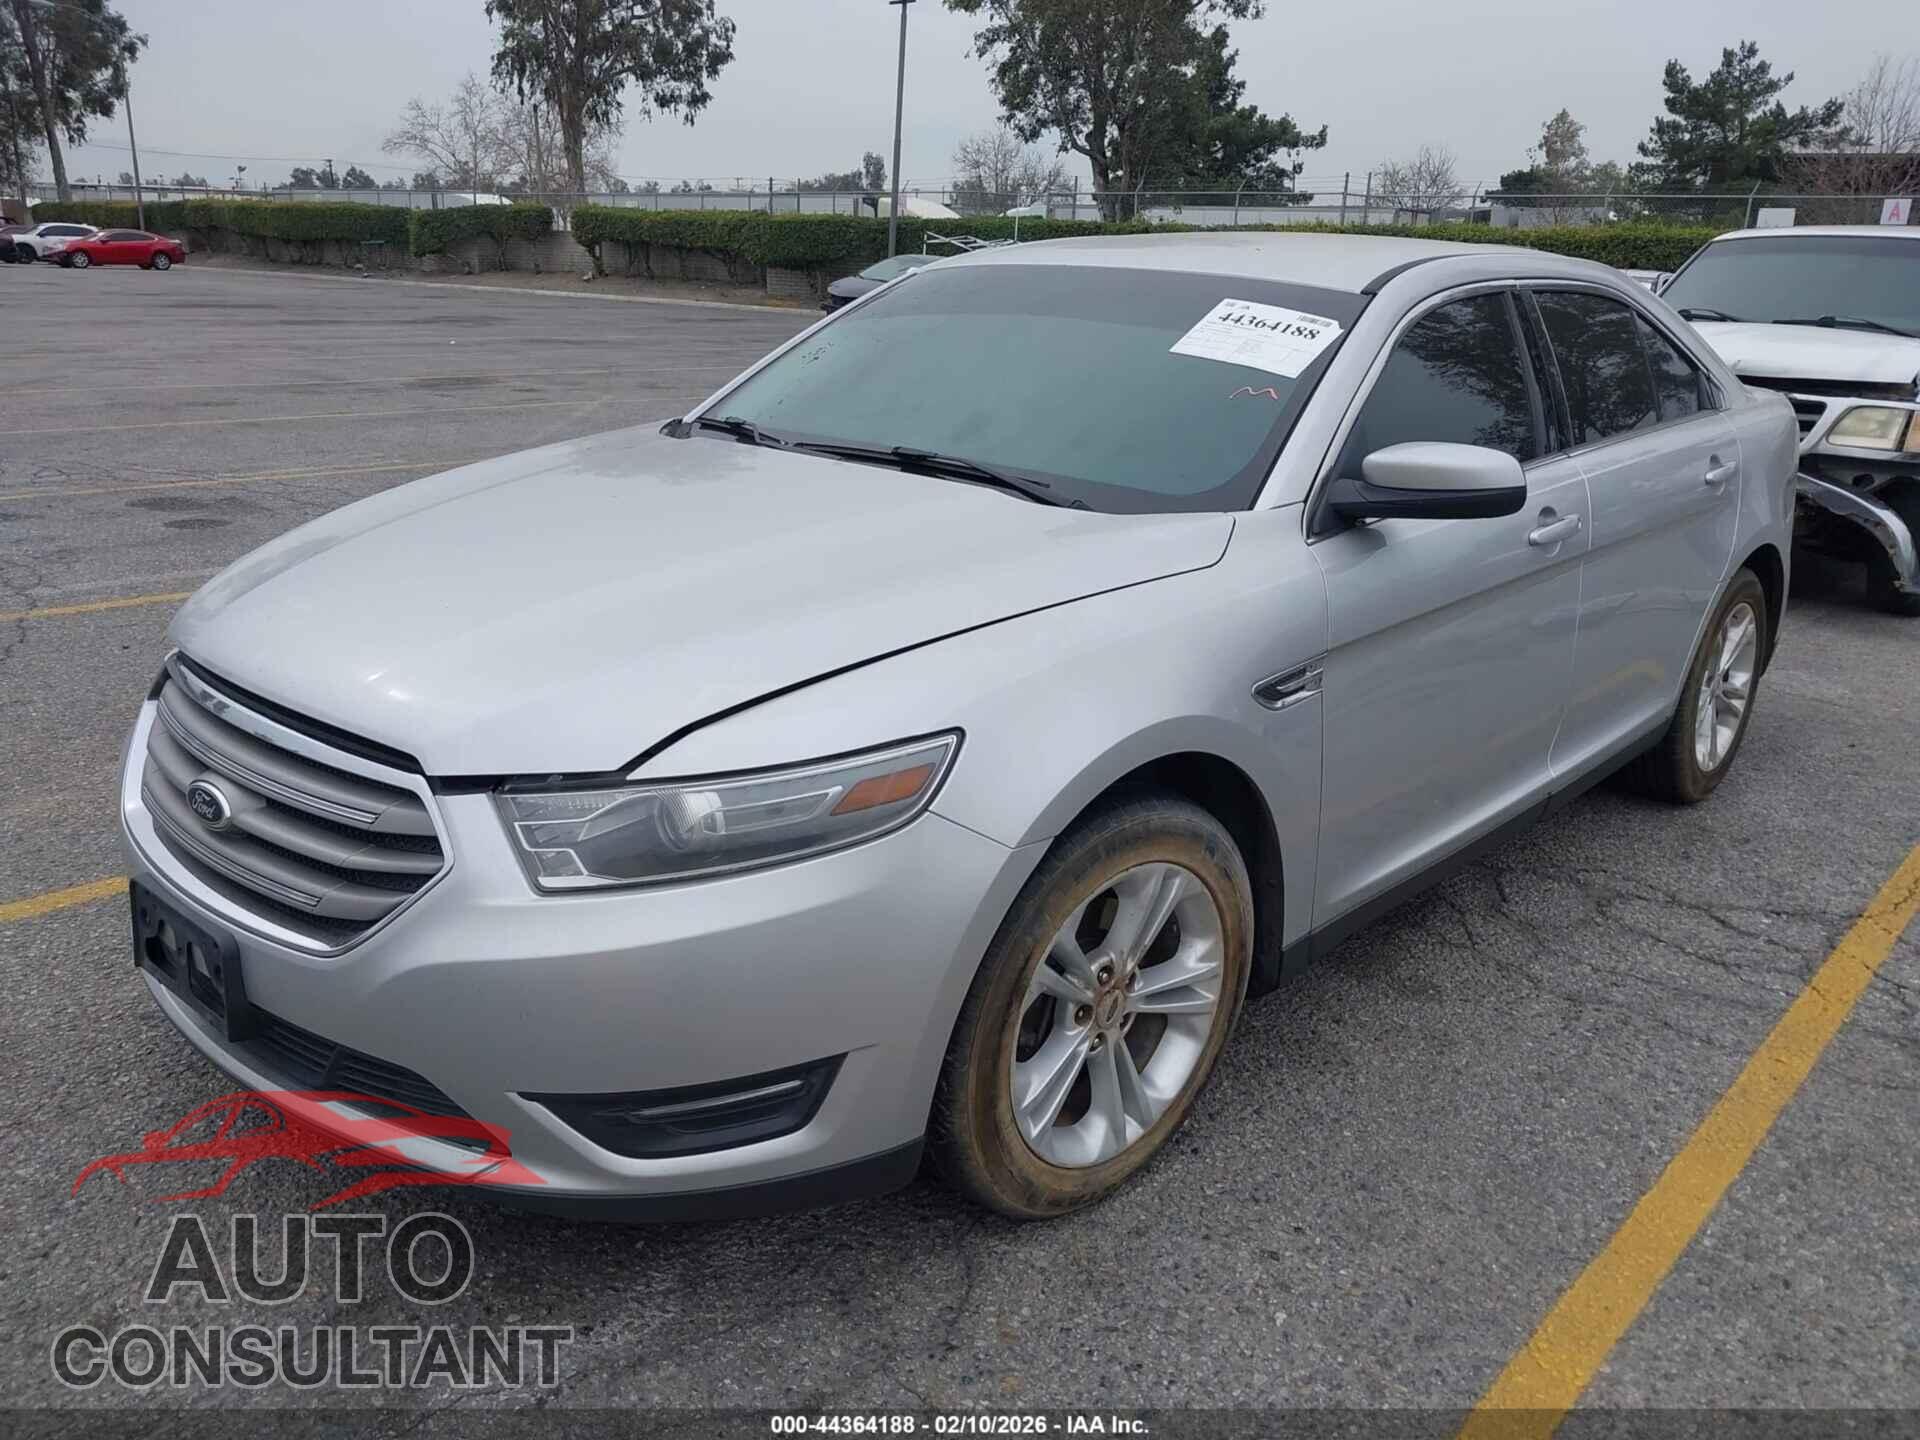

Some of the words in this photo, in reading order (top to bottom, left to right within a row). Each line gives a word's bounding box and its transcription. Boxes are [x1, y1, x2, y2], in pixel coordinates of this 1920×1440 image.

[1888, 201, 1904, 221] A
[1218, 312, 1320, 340] 44364188
[192, 790, 217, 818] Ford
